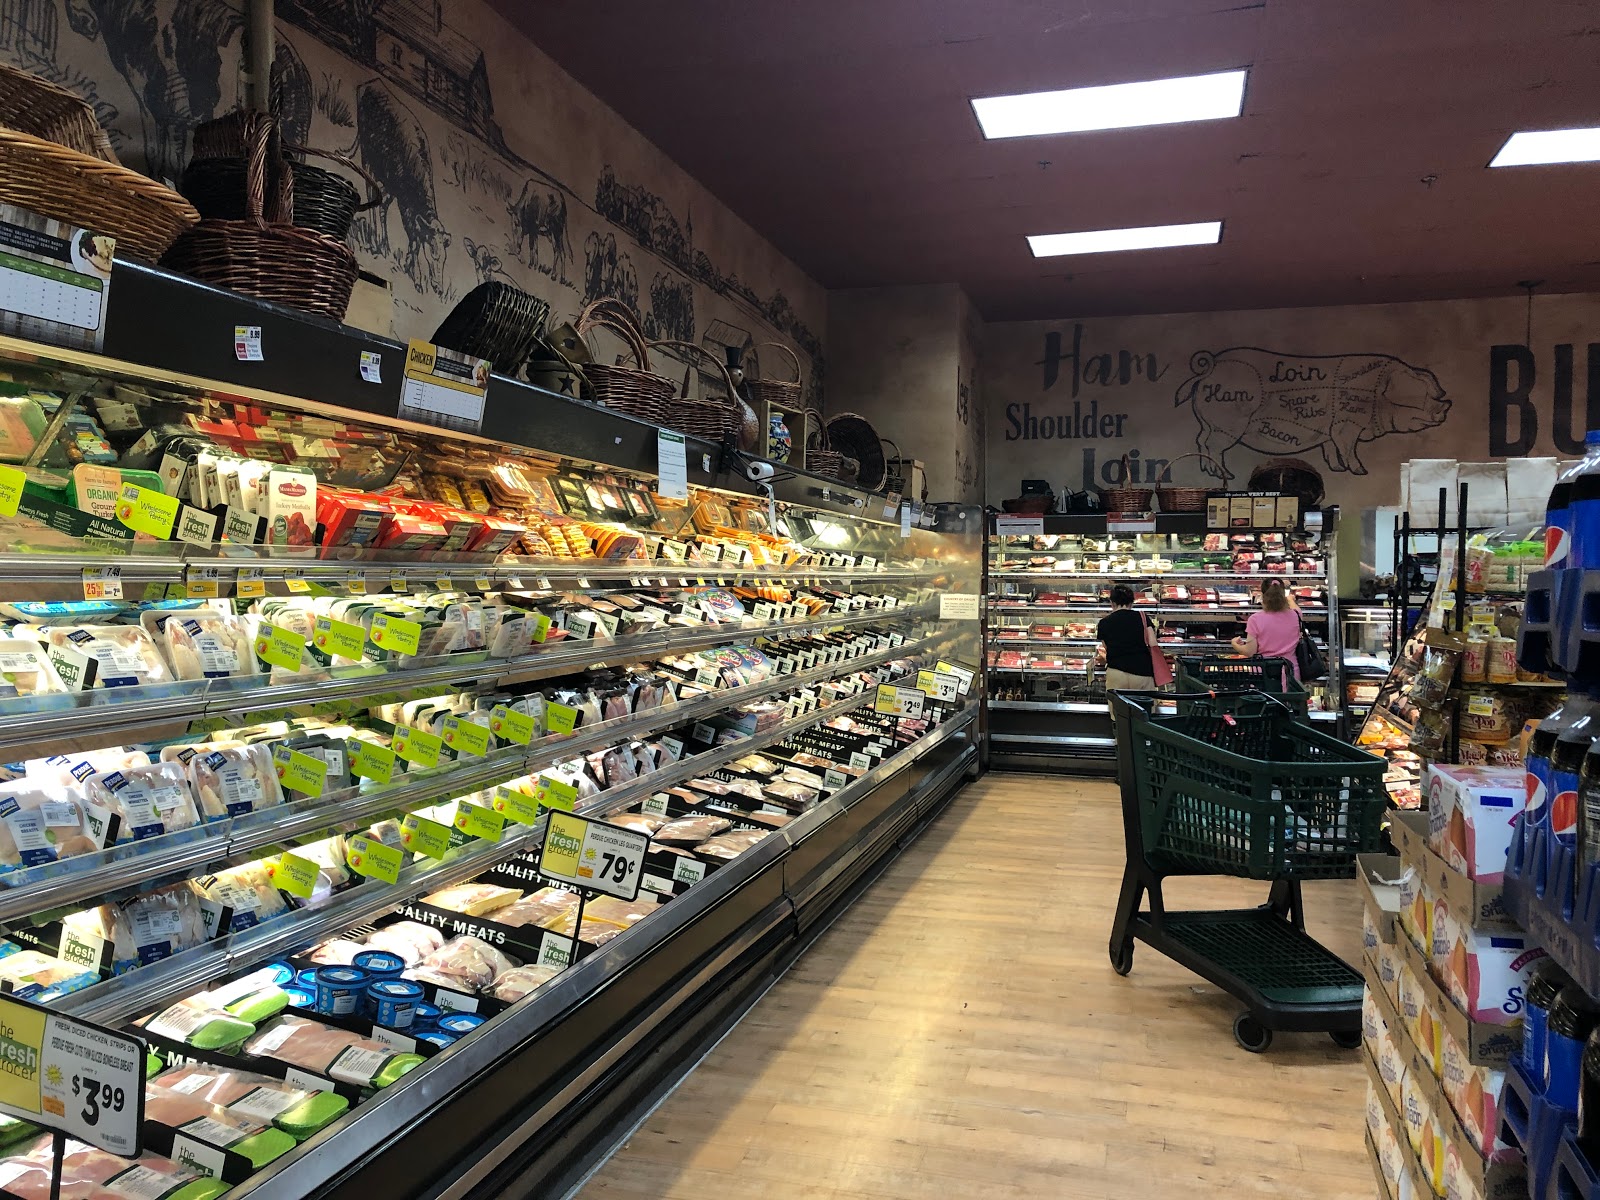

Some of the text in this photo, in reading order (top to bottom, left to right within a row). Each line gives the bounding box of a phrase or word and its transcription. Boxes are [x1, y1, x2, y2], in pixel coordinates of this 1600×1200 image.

[411, 348, 434, 366] CHICKEN
[1034, 323, 1171, 398] Ham
[1269, 361, 1327, 382] Loin
[1203, 384, 1254, 403] Ham
[1490, 343, 1600, 457] BU
[1006, 400, 1128, 440] Shoulder
[1294, 406, 1327, 420] Ribs
[1258, 421, 1302, 446] Bacon
[87, 488, 118, 501] ORGANIC
[91, 502, 117, 512] Ground
[140, 500, 172, 517] Wholesome
[89, 519, 100, 530] All
[100, 523, 127, 538] Natural
[184, 519, 210, 538] fresh
[227, 520, 251, 535] fresh
[53, 650, 65, 660] the
[805, 746, 832, 759] MEATS
[73, 763, 92, 778] PERDUE
[105, 775, 124, 790] PERDUE
[552, 823, 566, 835] the
[549, 832, 580, 852] fresh
[604, 836, 619, 846] CHICKEN
[547, 845, 578, 859] grocer
[599, 852, 635, 883] 79¢
[678, 868, 700, 880] fresh
[396, 908, 506, 945] UALITY MEATS
[67, 931, 80, 941] the
[64, 940, 95, 962] fresh
[64, 952, 92, 967] grocer
[544, 948, 571, 962] fresh
[0, 1020, 14, 1040] he
[55, 1021, 71, 1033] FRESH,
[72, 1027, 86, 1038] DICED
[109, 1039, 127, 1051] STRIPS
[127, 1045, 136, 1054] OR
[0, 1058, 36, 1082] rocer
[180, 1146, 196, 1160] the
